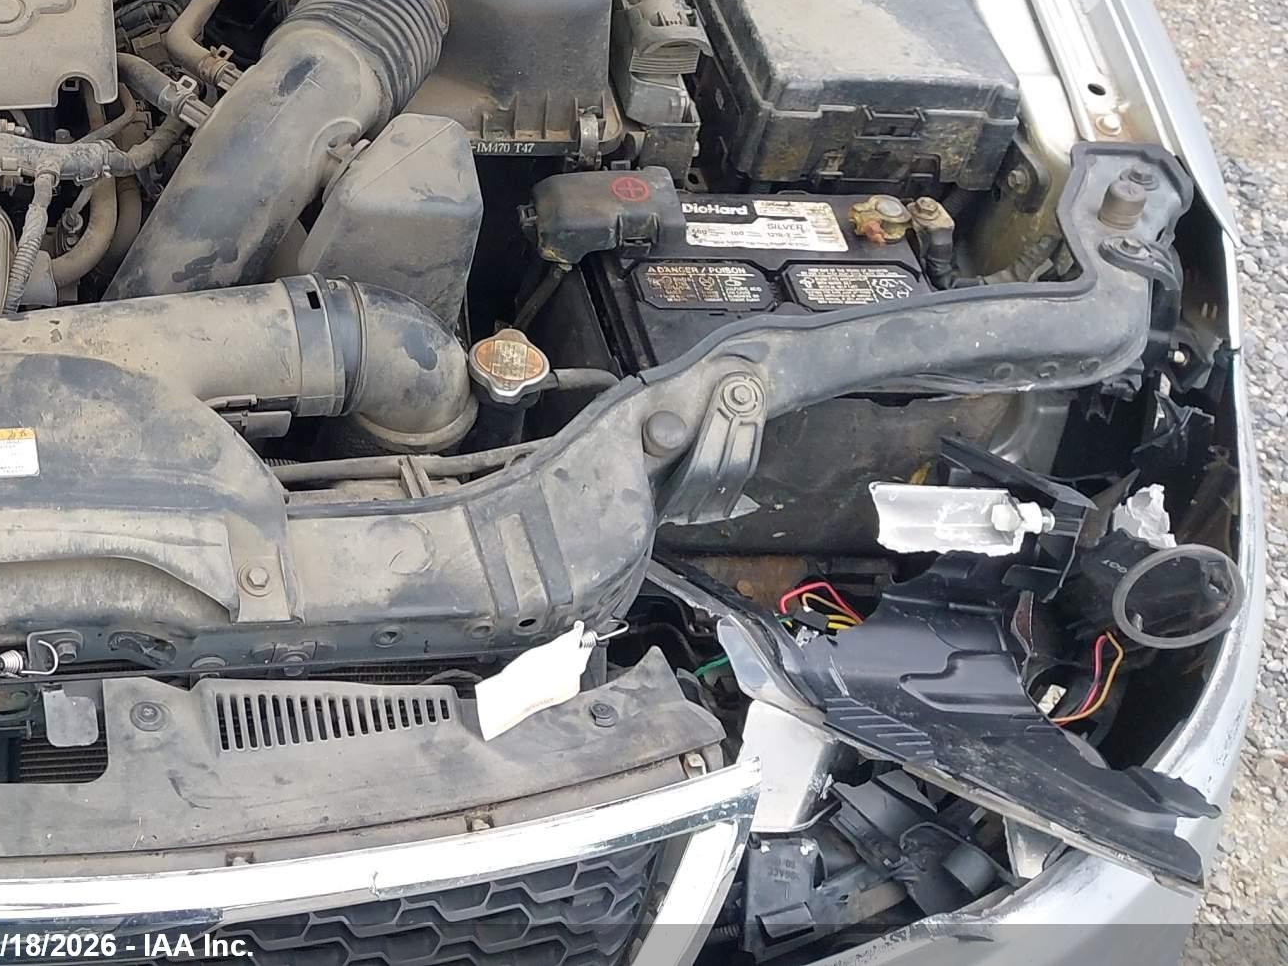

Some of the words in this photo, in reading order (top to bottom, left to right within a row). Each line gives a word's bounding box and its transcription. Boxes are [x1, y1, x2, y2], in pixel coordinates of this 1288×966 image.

[681, 202, 748, 216] DieHard
[657, 265, 699, 274] DANGER
[708, 266, 746, 274] POISON
